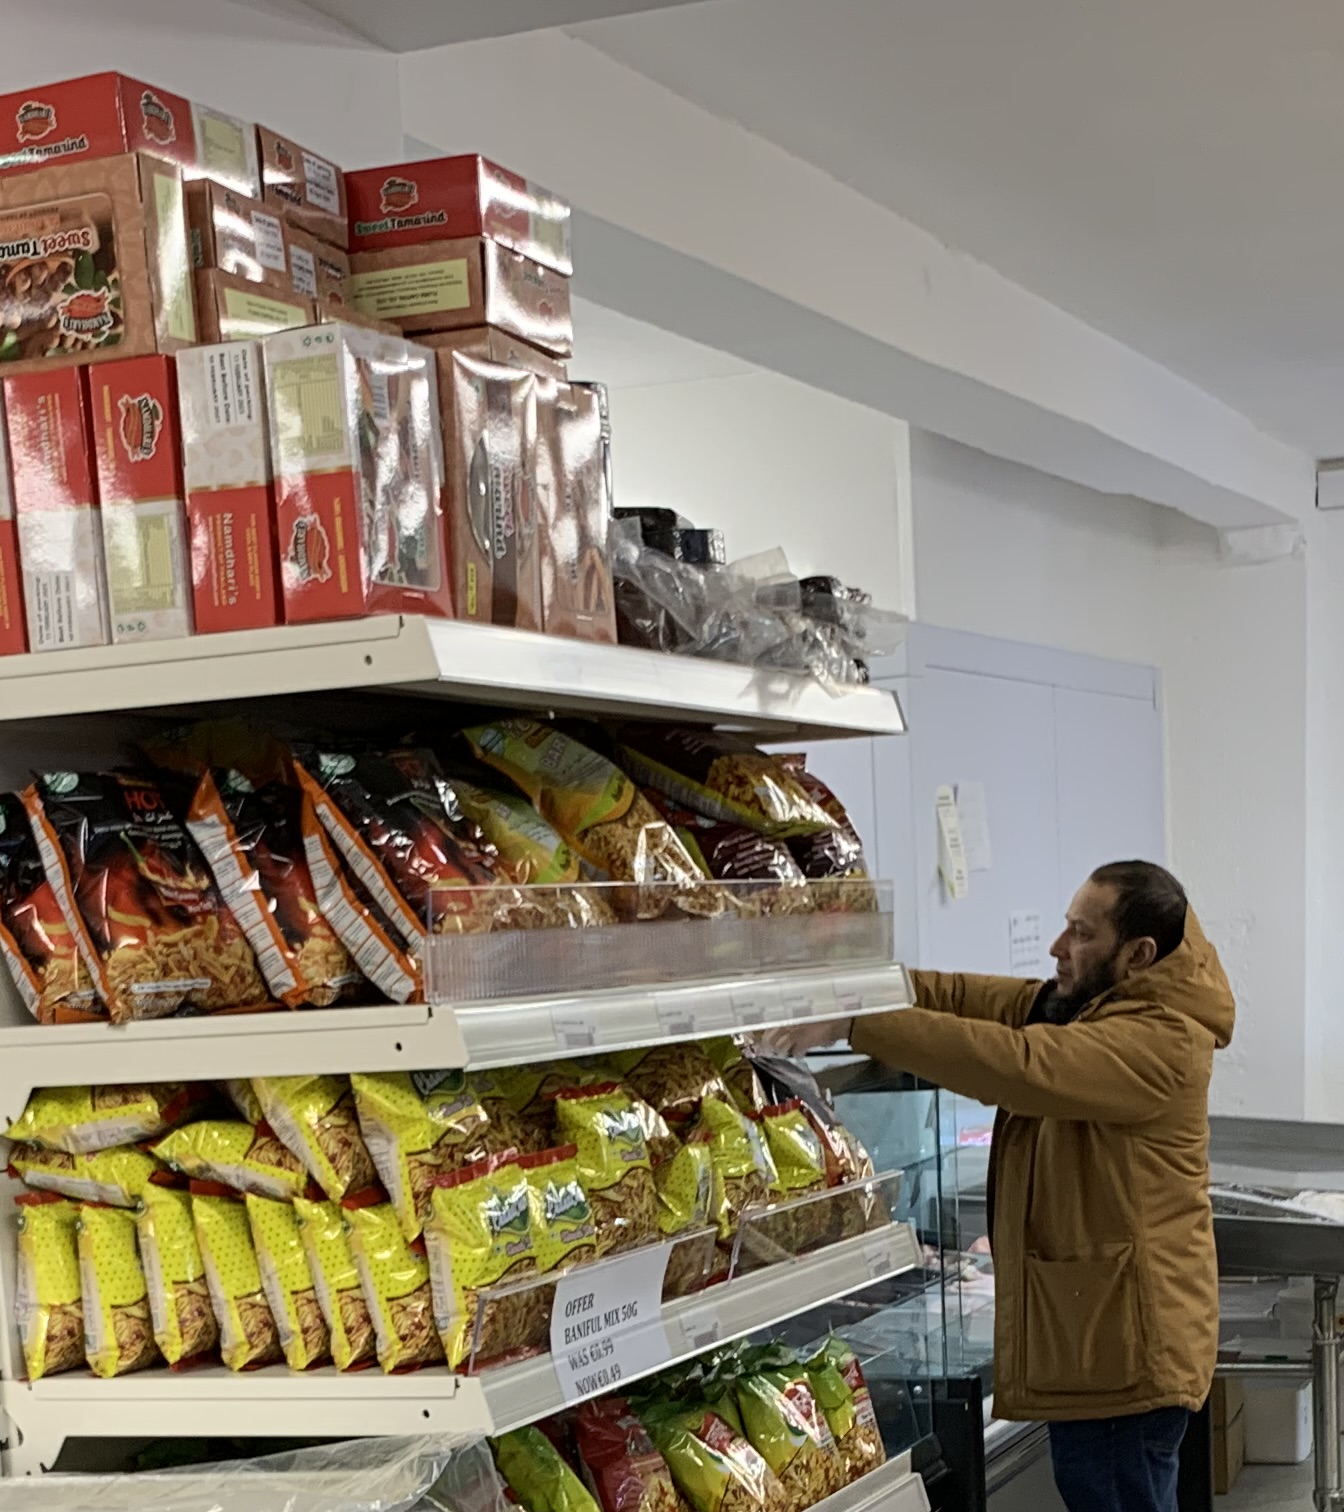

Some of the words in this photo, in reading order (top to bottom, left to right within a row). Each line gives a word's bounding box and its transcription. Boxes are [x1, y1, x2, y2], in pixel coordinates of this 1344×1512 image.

[391, 211, 445, 230] Tamarind
[41, 228, 91, 251] Sweet
[224, 513, 237, 605] Namdhari's
[565, 1293, 594, 1318] OFFER
[564, 1316, 603, 1345] BANIFUL
[604, 1307, 620, 1329] MIX
[621, 1300, 638, 1322] 50G
[567, 1347, 590, 1371] WAS
[574, 1372, 598, 1397] NOW
